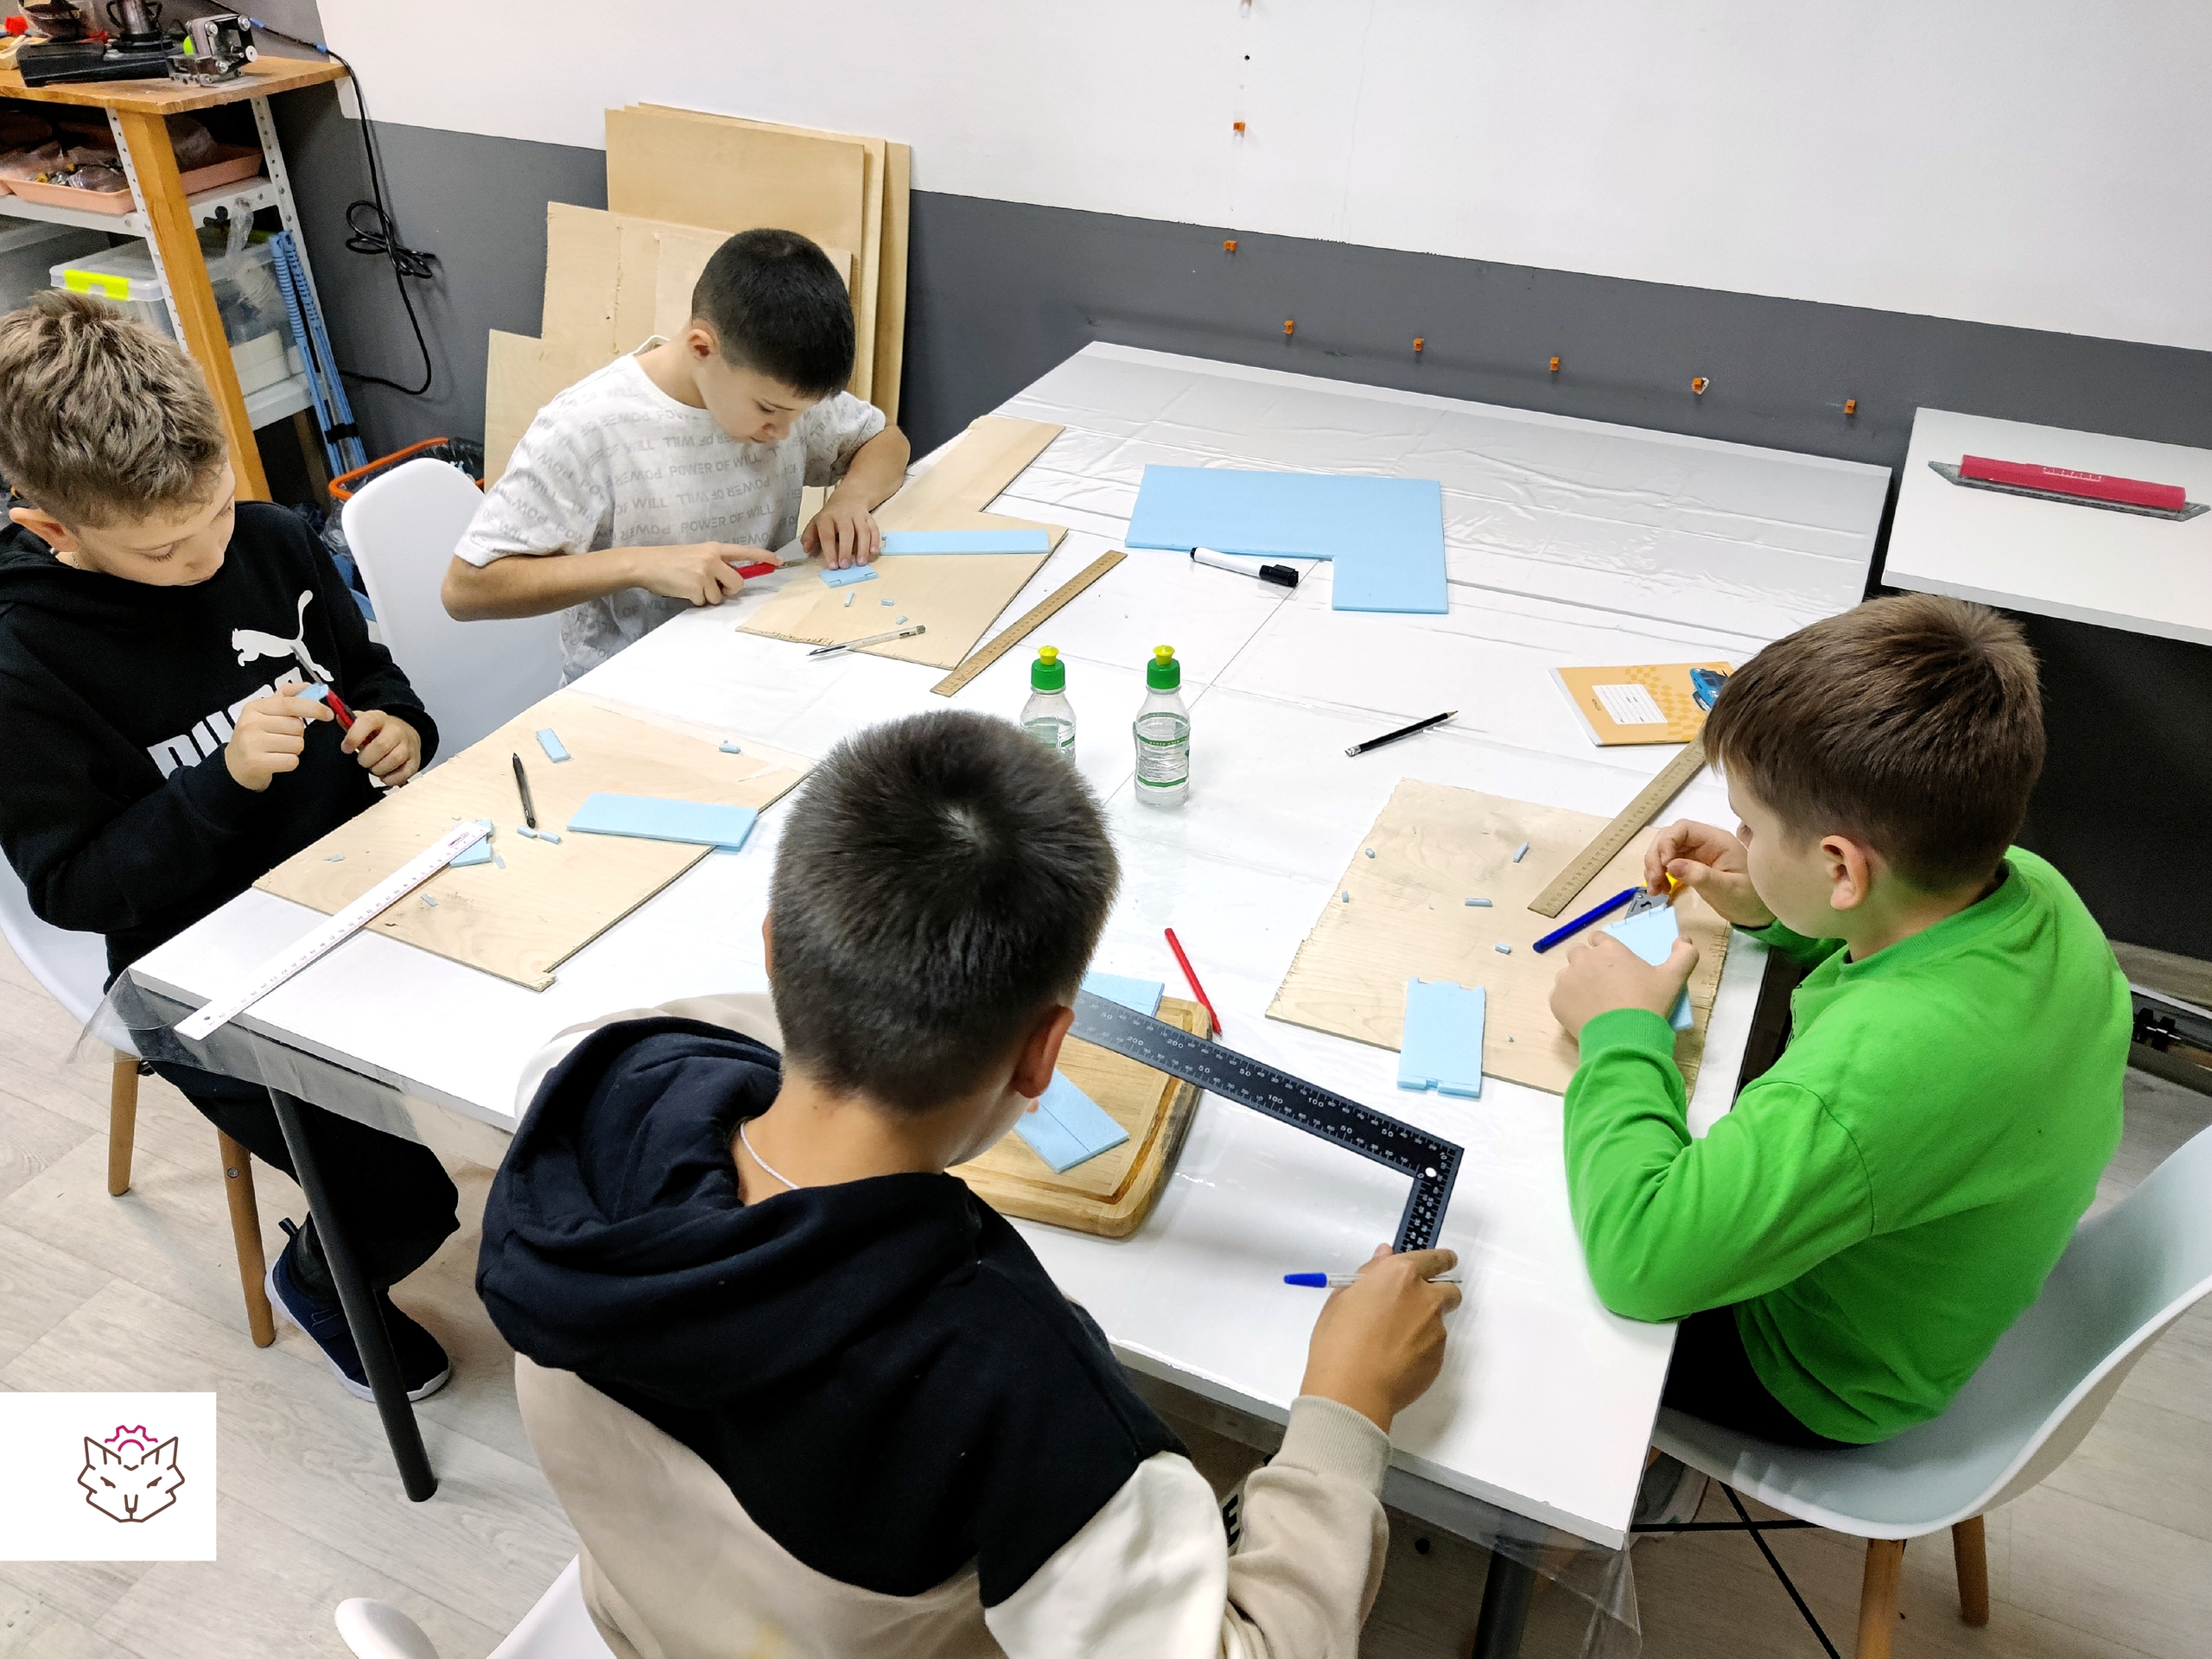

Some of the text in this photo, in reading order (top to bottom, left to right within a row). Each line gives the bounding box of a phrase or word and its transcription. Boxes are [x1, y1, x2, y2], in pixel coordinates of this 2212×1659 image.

[662, 436, 696, 448] WILL
[698, 435, 715, 446] OF
[668, 453, 762, 477] POWER OF WILL
[632, 497, 669, 510] WILL
[675, 476, 770, 505] WILL OF POWER
[680, 504, 775, 532] POWER OF WILL
[620, 524, 671, 542] POWER
[1101, 1011, 1113, 1020] 50
[1166, 1039, 1184, 1049] 200
[1239, 1068, 1251, 1077] 50
[1307, 1096, 1325, 1108] 100
[1381, 1128, 1394, 1138] 50
[1127, 1036, 1144, 1046] 200
[1198, 1065, 1211, 1074] 50
[1268, 1094, 1283, 1104] 100
[1340, 1125, 1353, 1135] 50
